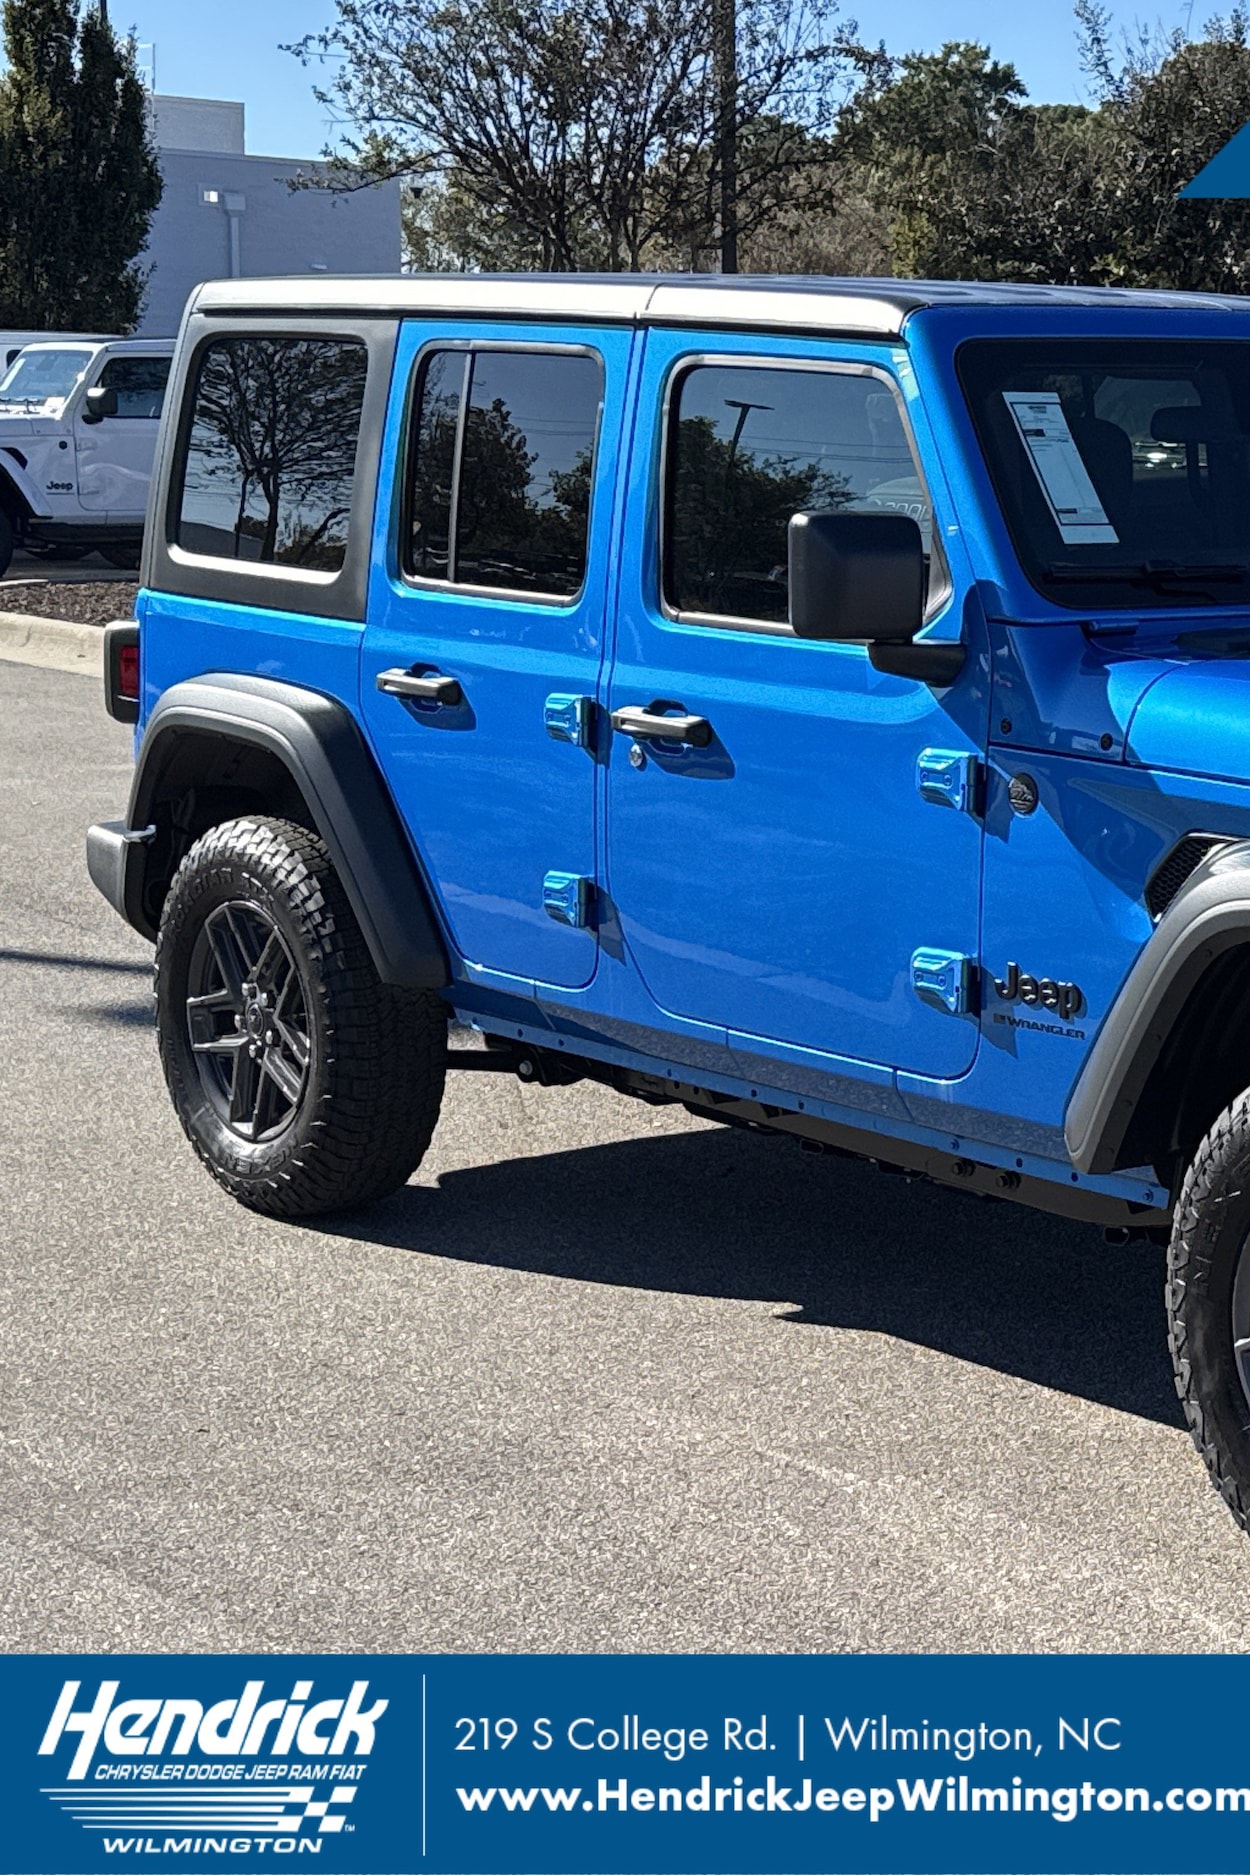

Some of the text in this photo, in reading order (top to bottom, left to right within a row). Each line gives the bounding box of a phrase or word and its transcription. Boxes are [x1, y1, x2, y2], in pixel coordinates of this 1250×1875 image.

[46, 480, 74, 491] Jeep
[994, 961, 1083, 1020] Jeep
[1007, 1015, 1085, 1040] WRANGLER
